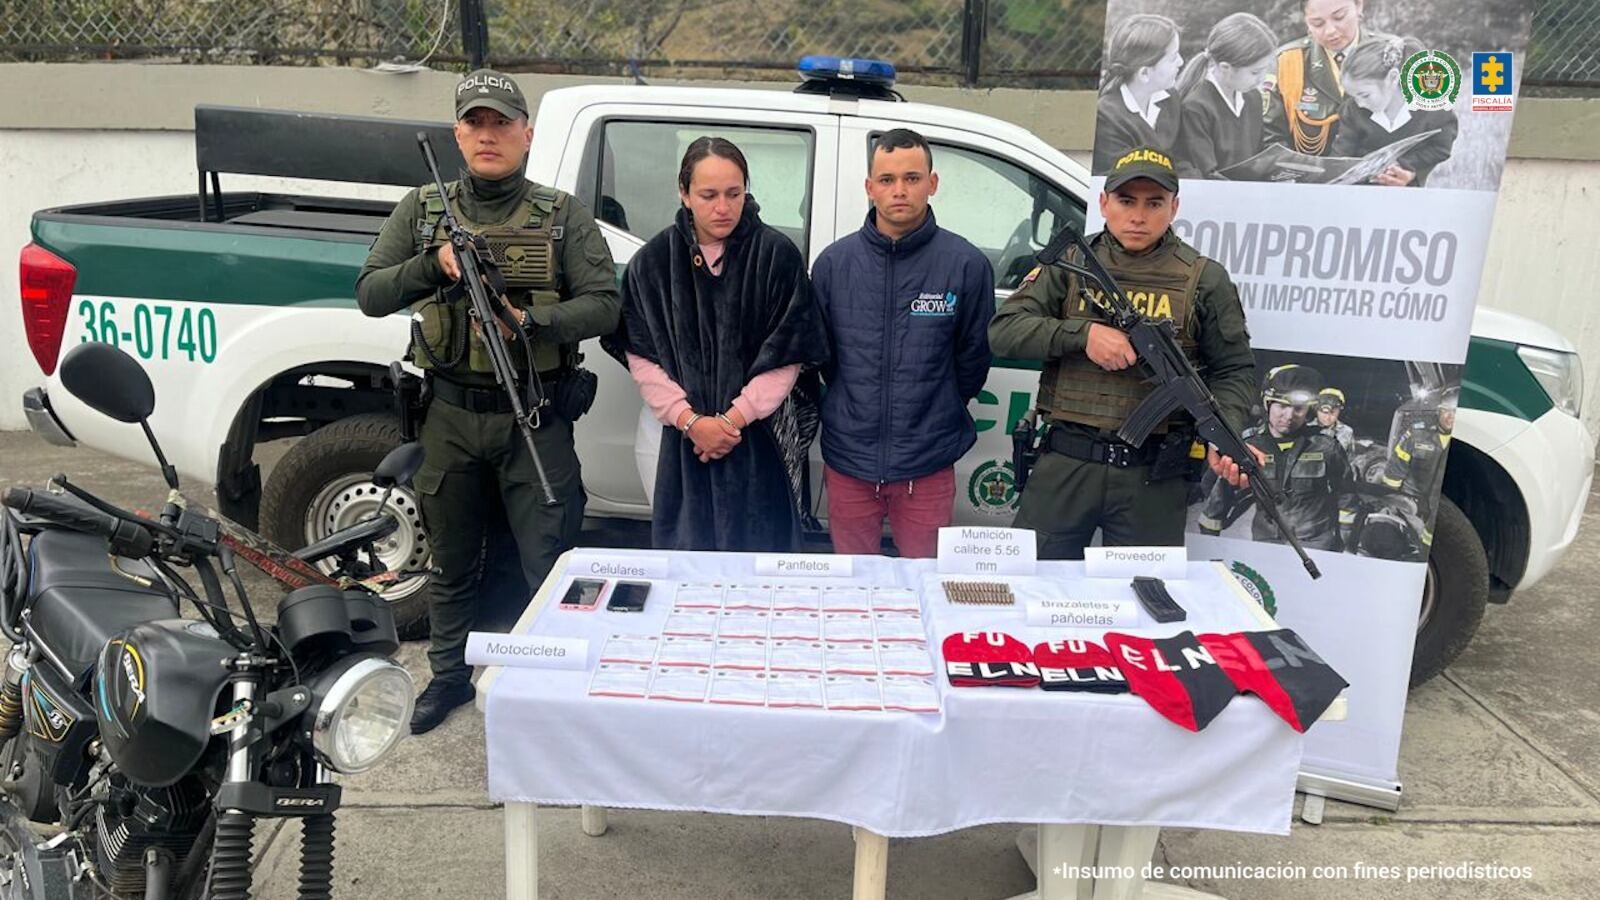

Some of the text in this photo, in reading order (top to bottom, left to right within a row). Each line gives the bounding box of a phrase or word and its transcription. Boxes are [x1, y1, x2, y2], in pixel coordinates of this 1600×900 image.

[911, 299, 947, 312] GROW
[1261, 283, 1374, 318] IMPORTAR
[1379, 286, 1448, 323] CÓMO
[79, 300, 217, 364] 36-0740
[962, 527, 1013, 541] Munición
[953, 544, 1021, 556] calibre 5.56
[1105, 550, 1166, 562] Proveedor
[590, 562, 646, 577] Celulares
[777, 559, 830, 572] Panfletos
[975, 562, 998, 572] mm
[1113, 602, 1121, 612] y
[1050, 612, 1114, 626] pañoletas
[962, 631, 1005, 647] FU
[486, 642, 566, 658] Motocicleta
[1048, 640, 1088, 654] FU
[1120, 643, 1218, 673] ELN
[947, 661, 1041, 678] ELN
[1040, 667, 1126, 682] ELN
